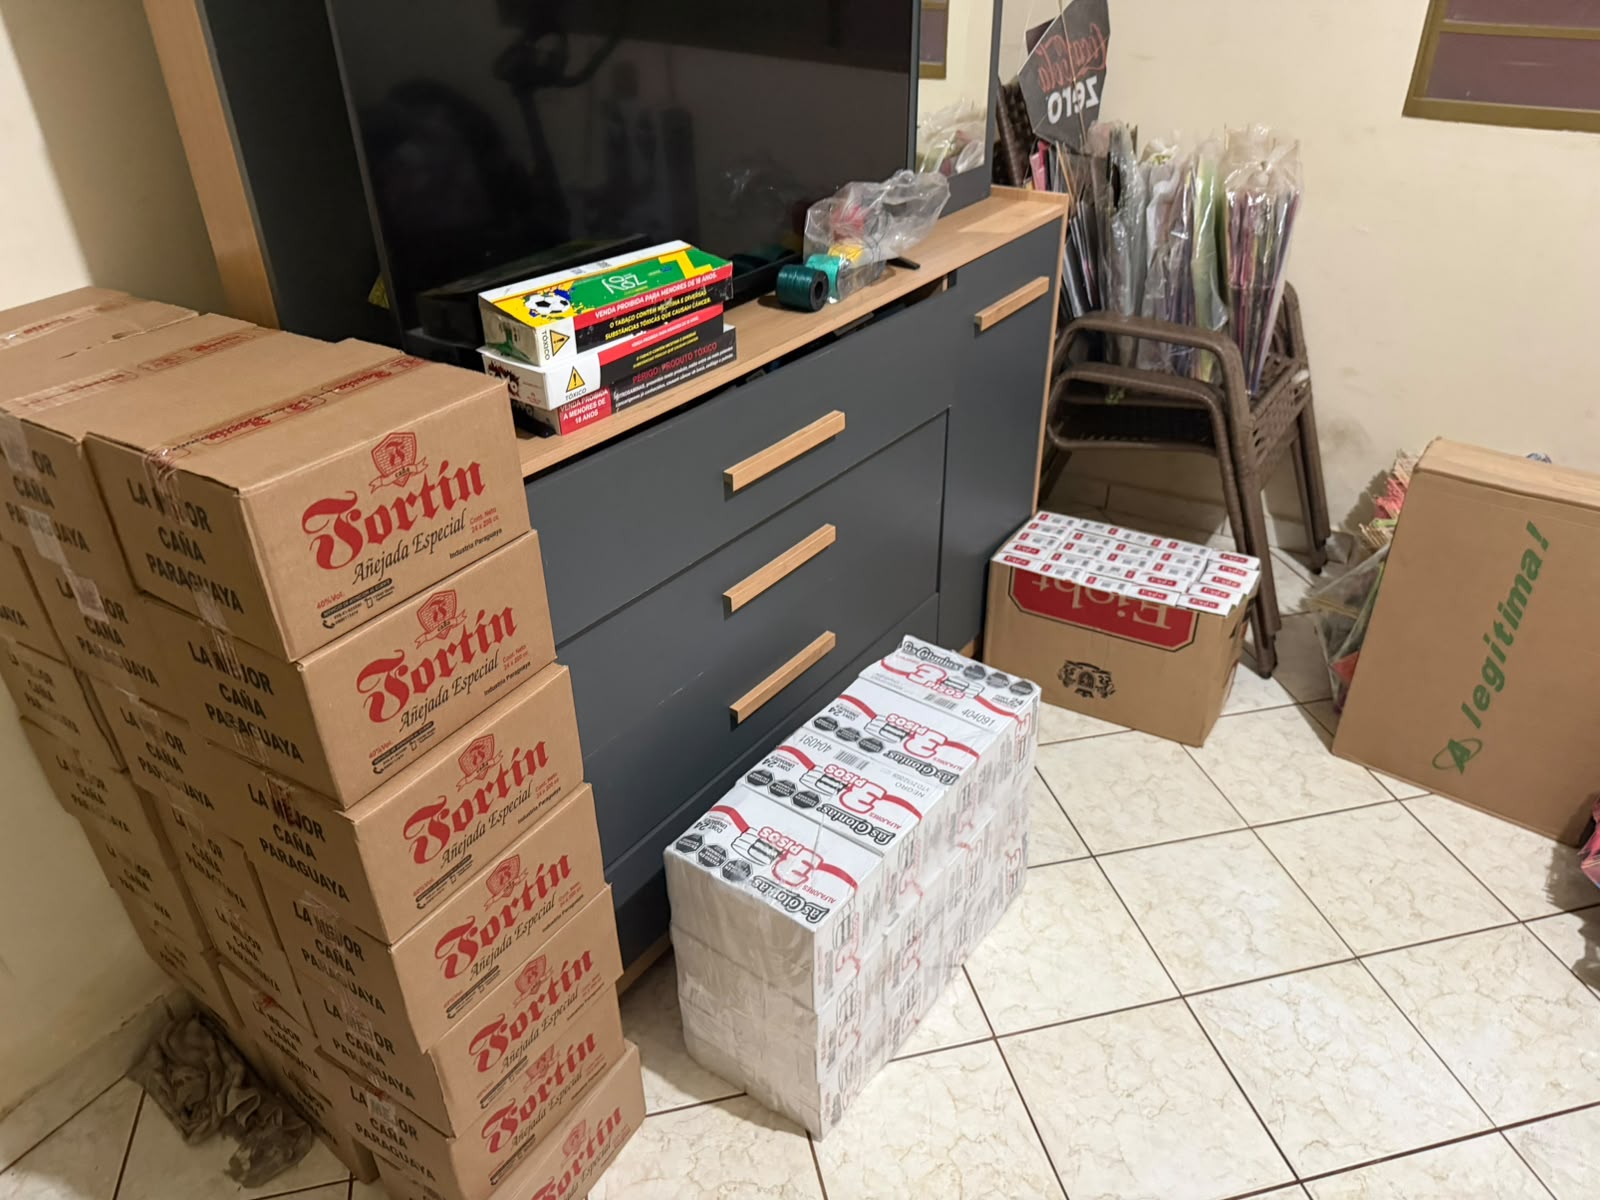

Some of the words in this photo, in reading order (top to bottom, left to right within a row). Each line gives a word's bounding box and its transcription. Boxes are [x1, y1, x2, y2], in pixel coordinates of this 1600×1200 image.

[595, 307, 616, 319] VENDA
[616, 297, 644, 312] PROIBIDA
[644, 292, 660, 303] PARA
[660, 282, 687, 297] MENORES
[687, 279, 695, 288] DE
[661, 311, 671, 321] QUE
[671, 303, 692, 316] CAUSAM
[541, 330, 550, 361] TÓXICO
[661, 352, 694, 371] PRODUTO
[560, 400, 581, 412] VENDA
[565, 388, 587, 400] TÓXICO
[568, 401, 597, 418] MENORES
[597, 398, 606, 406] DE
[575, 416, 581, 424] 18
[582, 410, 598, 421] ANOS
[12, 475, 55, 509] CAÑA
[126, 478, 151, 509] LA
[301, 459, 486, 571] Fortín
[157, 526, 206, 564] CAÑA
[352, 543, 410, 586] Añejada
[412, 508, 467, 556] Especial
[449, 541, 474, 560] Industria
[187, 640, 212, 666] LA
[356, 606, 518, 723] Fortín
[399, 687, 450, 733] Añejada
[451, 649, 500, 697] Especial
[905, 663, 947, 688] 3
[924, 679, 966, 700] PISOS
[218, 682, 267, 720] CAÑA
[828, 705, 842, 717] 24
[885, 713, 930, 736] PISOS
[961, 708, 997, 728] 404091
[800, 733, 832, 753] 404091
[903, 728, 948, 759] 3
[762, 757, 778, 769] 24
[823, 763, 868, 788] PISOS
[882, 749, 939, 777] Colonias
[402, 740, 549, 864] Fortín
[839, 781, 888, 815] 3
[895, 781, 926, 798] NEGRO
[248, 783, 270, 810] LA
[270, 799, 327, 843] MEJOR
[440, 822, 486, 869] Añejada
[488, 781, 534, 832] Especial
[693, 820, 709, 831] 24
[815, 803, 873, 836] Colonias
[868, 811, 902, 830] ALFAJORES
[272, 823, 318, 861] CAÑA
[758, 826, 806, 856] PISOS
[259, 837, 350, 903] PARAGUAYA
[771, 849, 825, 888] 3
[801, 884, 837, 905] ALFAJORES
[292, 900, 313, 926] LA
[434, 854, 572, 979] Fortín
[801, 901, 830, 924] Las
[468, 935, 512, 981] Añejada
[513, 893, 556, 942] Especial
[314, 938, 356, 977] CAÑA
[322, 997, 343, 1021] LA
[468, 950, 595, 1073] Fortín
[500, 1028, 540, 1074] Añejada
[541, 986, 579, 1032] Especial
[345, 1031, 387, 1066] CAÑA
[349, 1085, 368, 1109] LA
[480, 1032, 597, 1154] Fortín
[369, 1117, 408, 1150] CAÑA
[355, 1122, 436, 1182] PARAGUAYA
